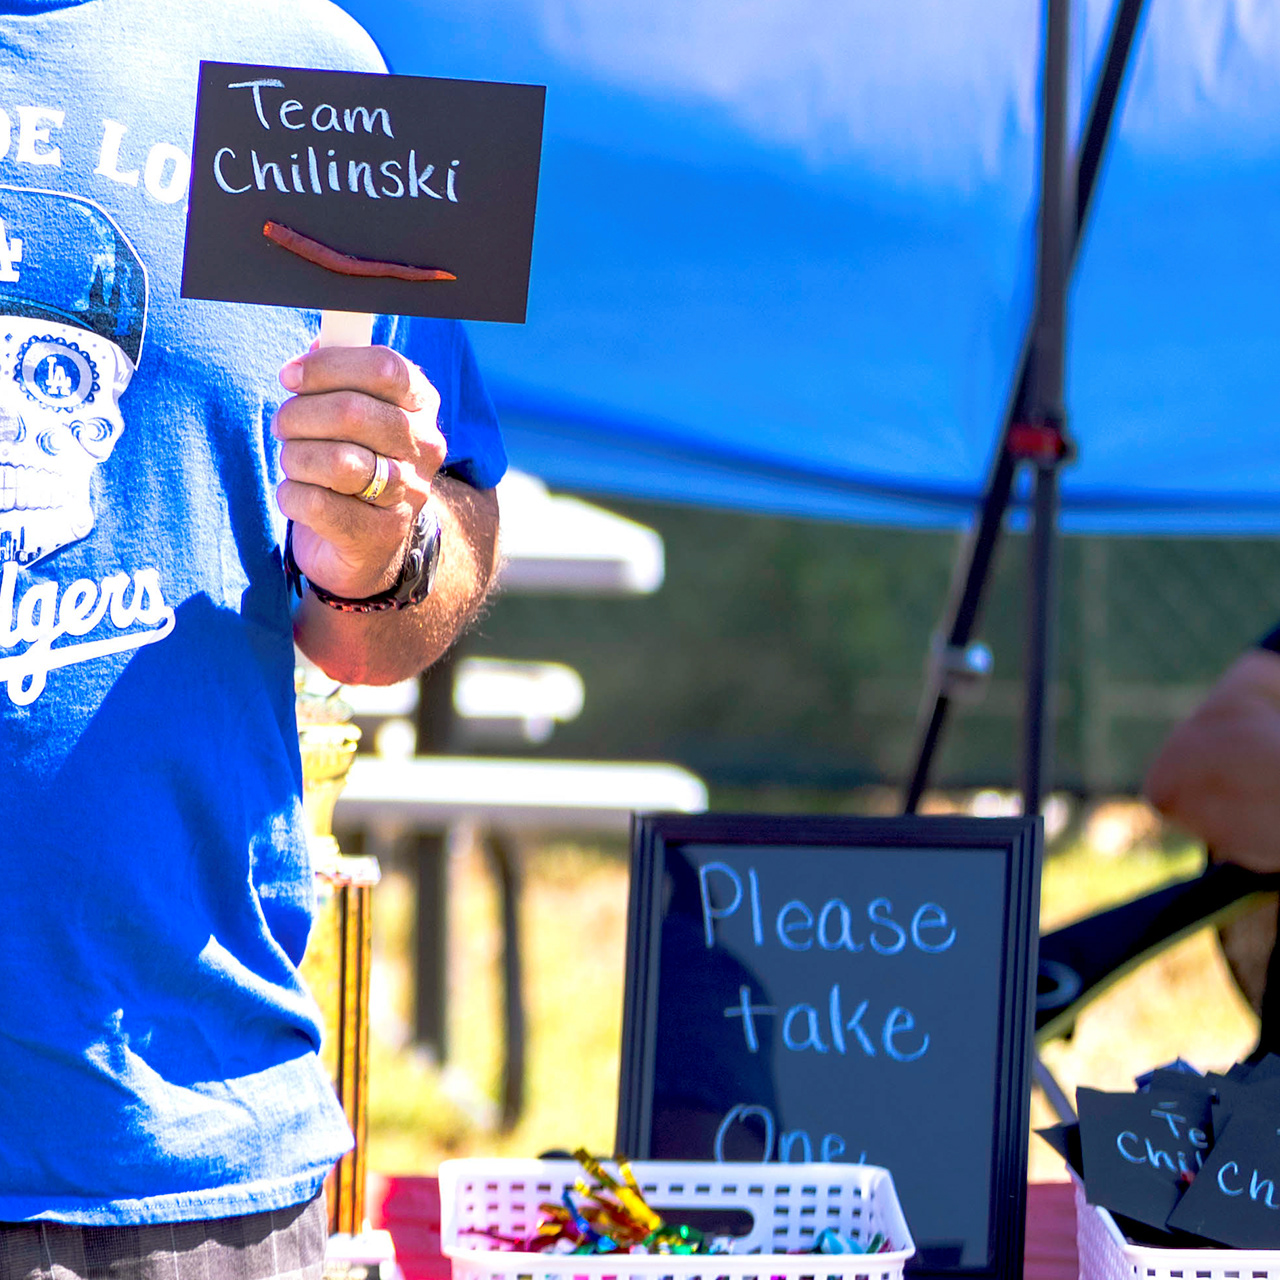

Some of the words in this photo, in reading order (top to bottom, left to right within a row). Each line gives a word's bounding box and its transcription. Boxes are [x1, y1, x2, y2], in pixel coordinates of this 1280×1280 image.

[228, 78, 394, 138] Team
[93, 119, 189, 214] LO
[213, 146, 460, 202] Chilinski
[45, 356, 72, 396] LA
[699, 861, 957, 956] Please
[723, 983, 930, 1062] take
